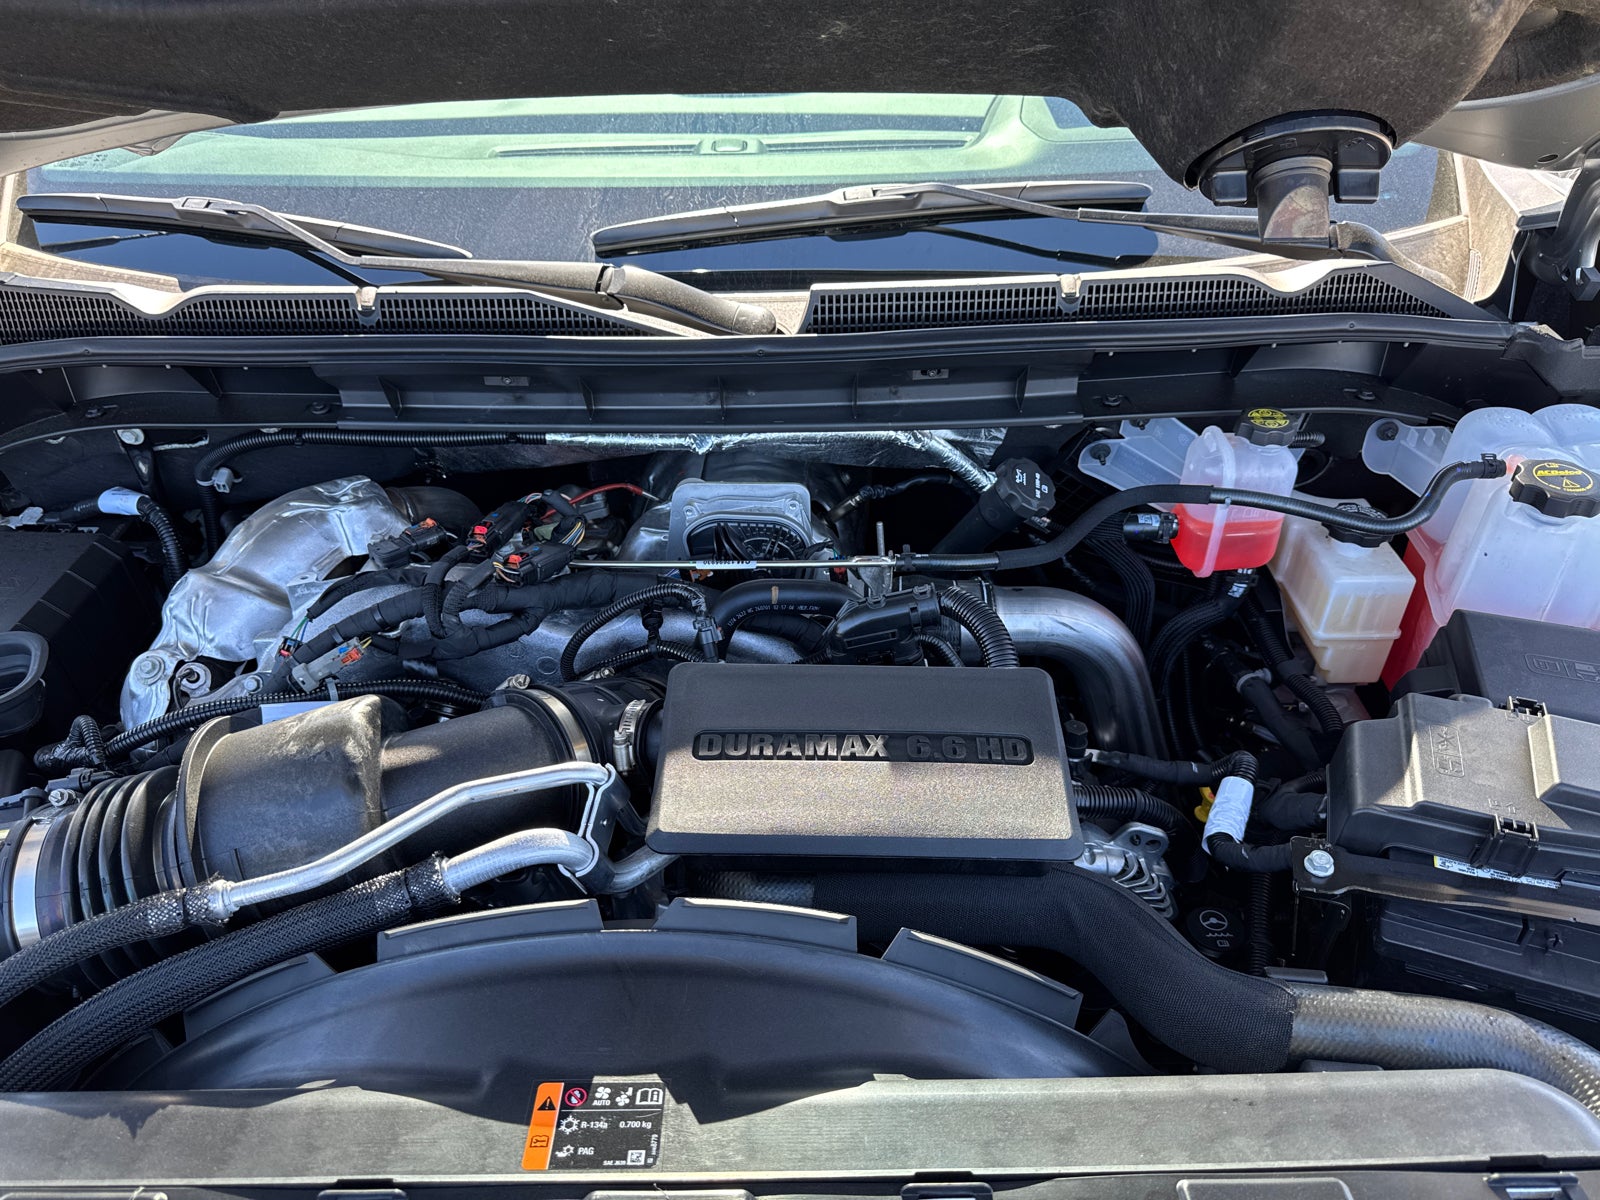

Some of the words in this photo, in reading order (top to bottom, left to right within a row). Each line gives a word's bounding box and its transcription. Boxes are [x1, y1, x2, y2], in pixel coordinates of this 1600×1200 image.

[1536, 469, 1583, 477] ACDelco
[698, 732, 890, 759] DURAMAX
[906, 734, 968, 760] 6.6
[976, 736, 1029, 761] HD
[580, 1121, 608, 1129] R-134a
[619, 1121, 641, 1129] 0.700
[641, 1121, 652, 1130] kg
[577, 1147, 595, 1156] PAG
